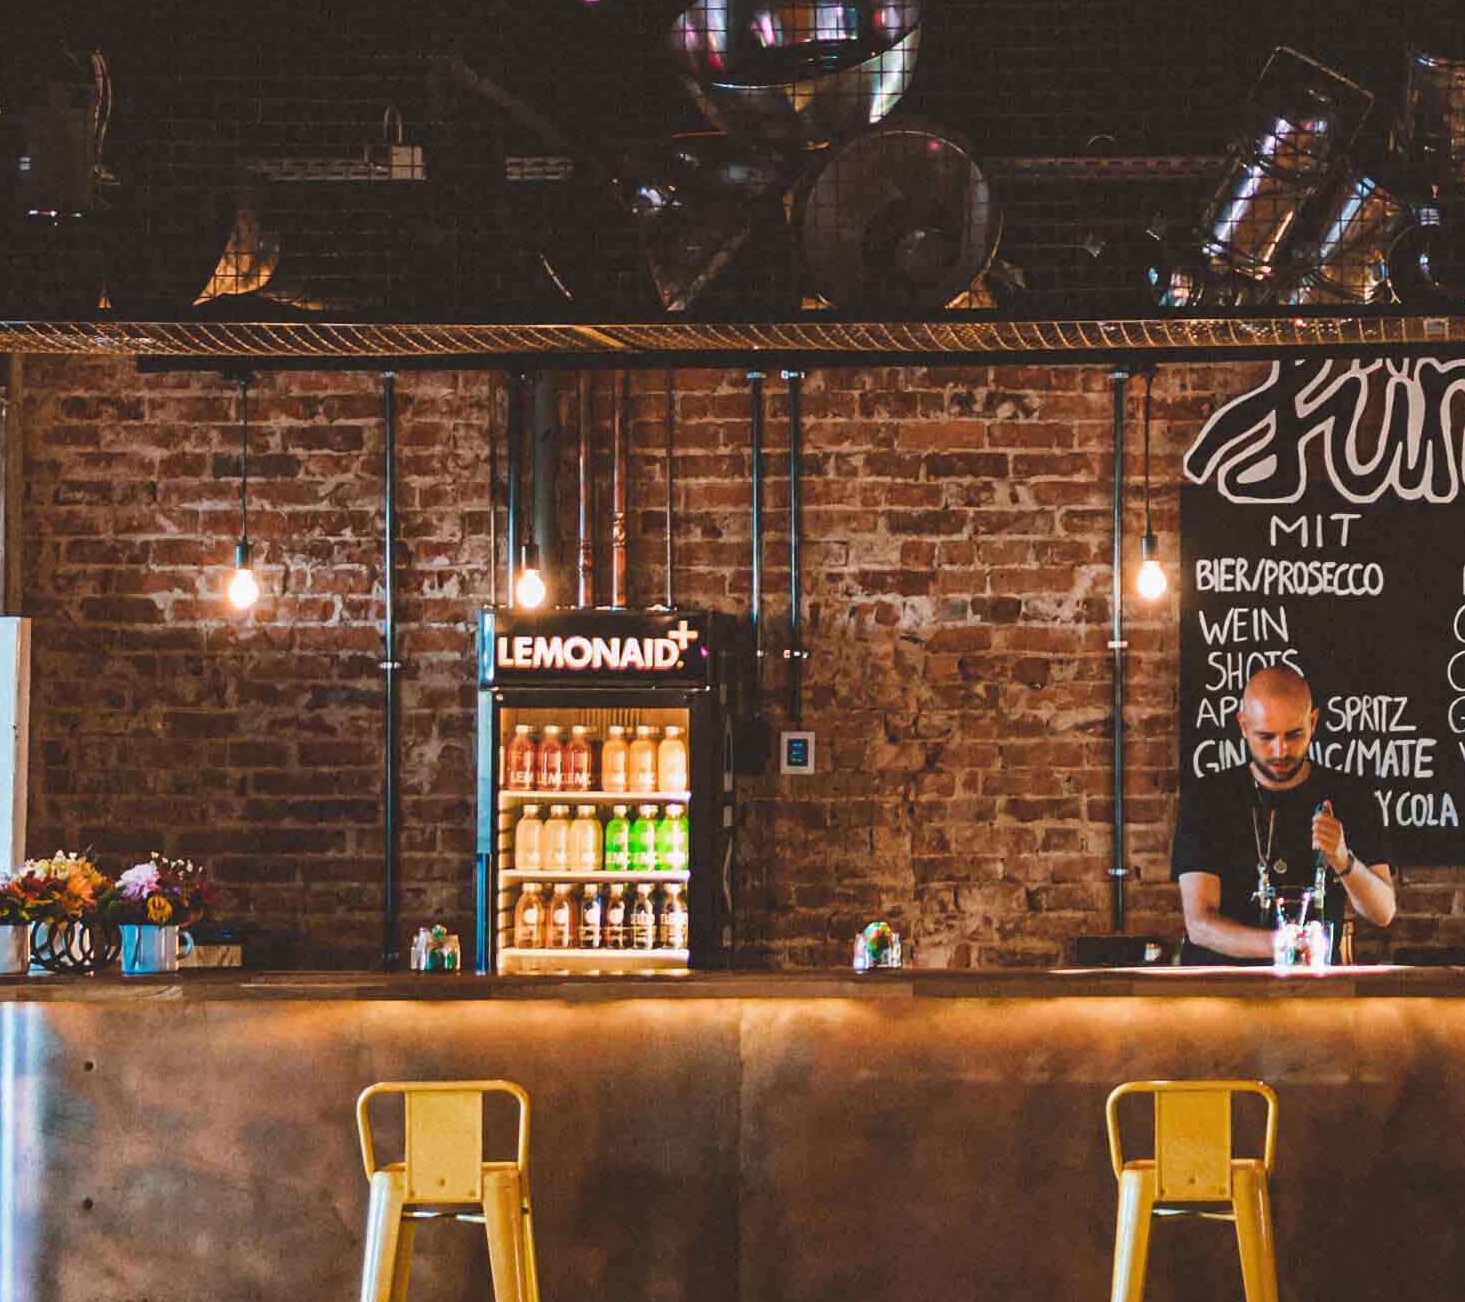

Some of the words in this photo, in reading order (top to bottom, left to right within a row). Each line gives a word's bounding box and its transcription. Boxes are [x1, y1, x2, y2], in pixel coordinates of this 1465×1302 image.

[1270, 513, 1362, 548] MIT
[1196, 557, 1384, 596] BIER/PROSECCO
[1198, 606, 1290, 645] WEIN
[1325, 695, 1417, 732] SPRITZ
[1192, 739, 1247, 778] GIN
[1395, 791, 1460, 827] COLA
